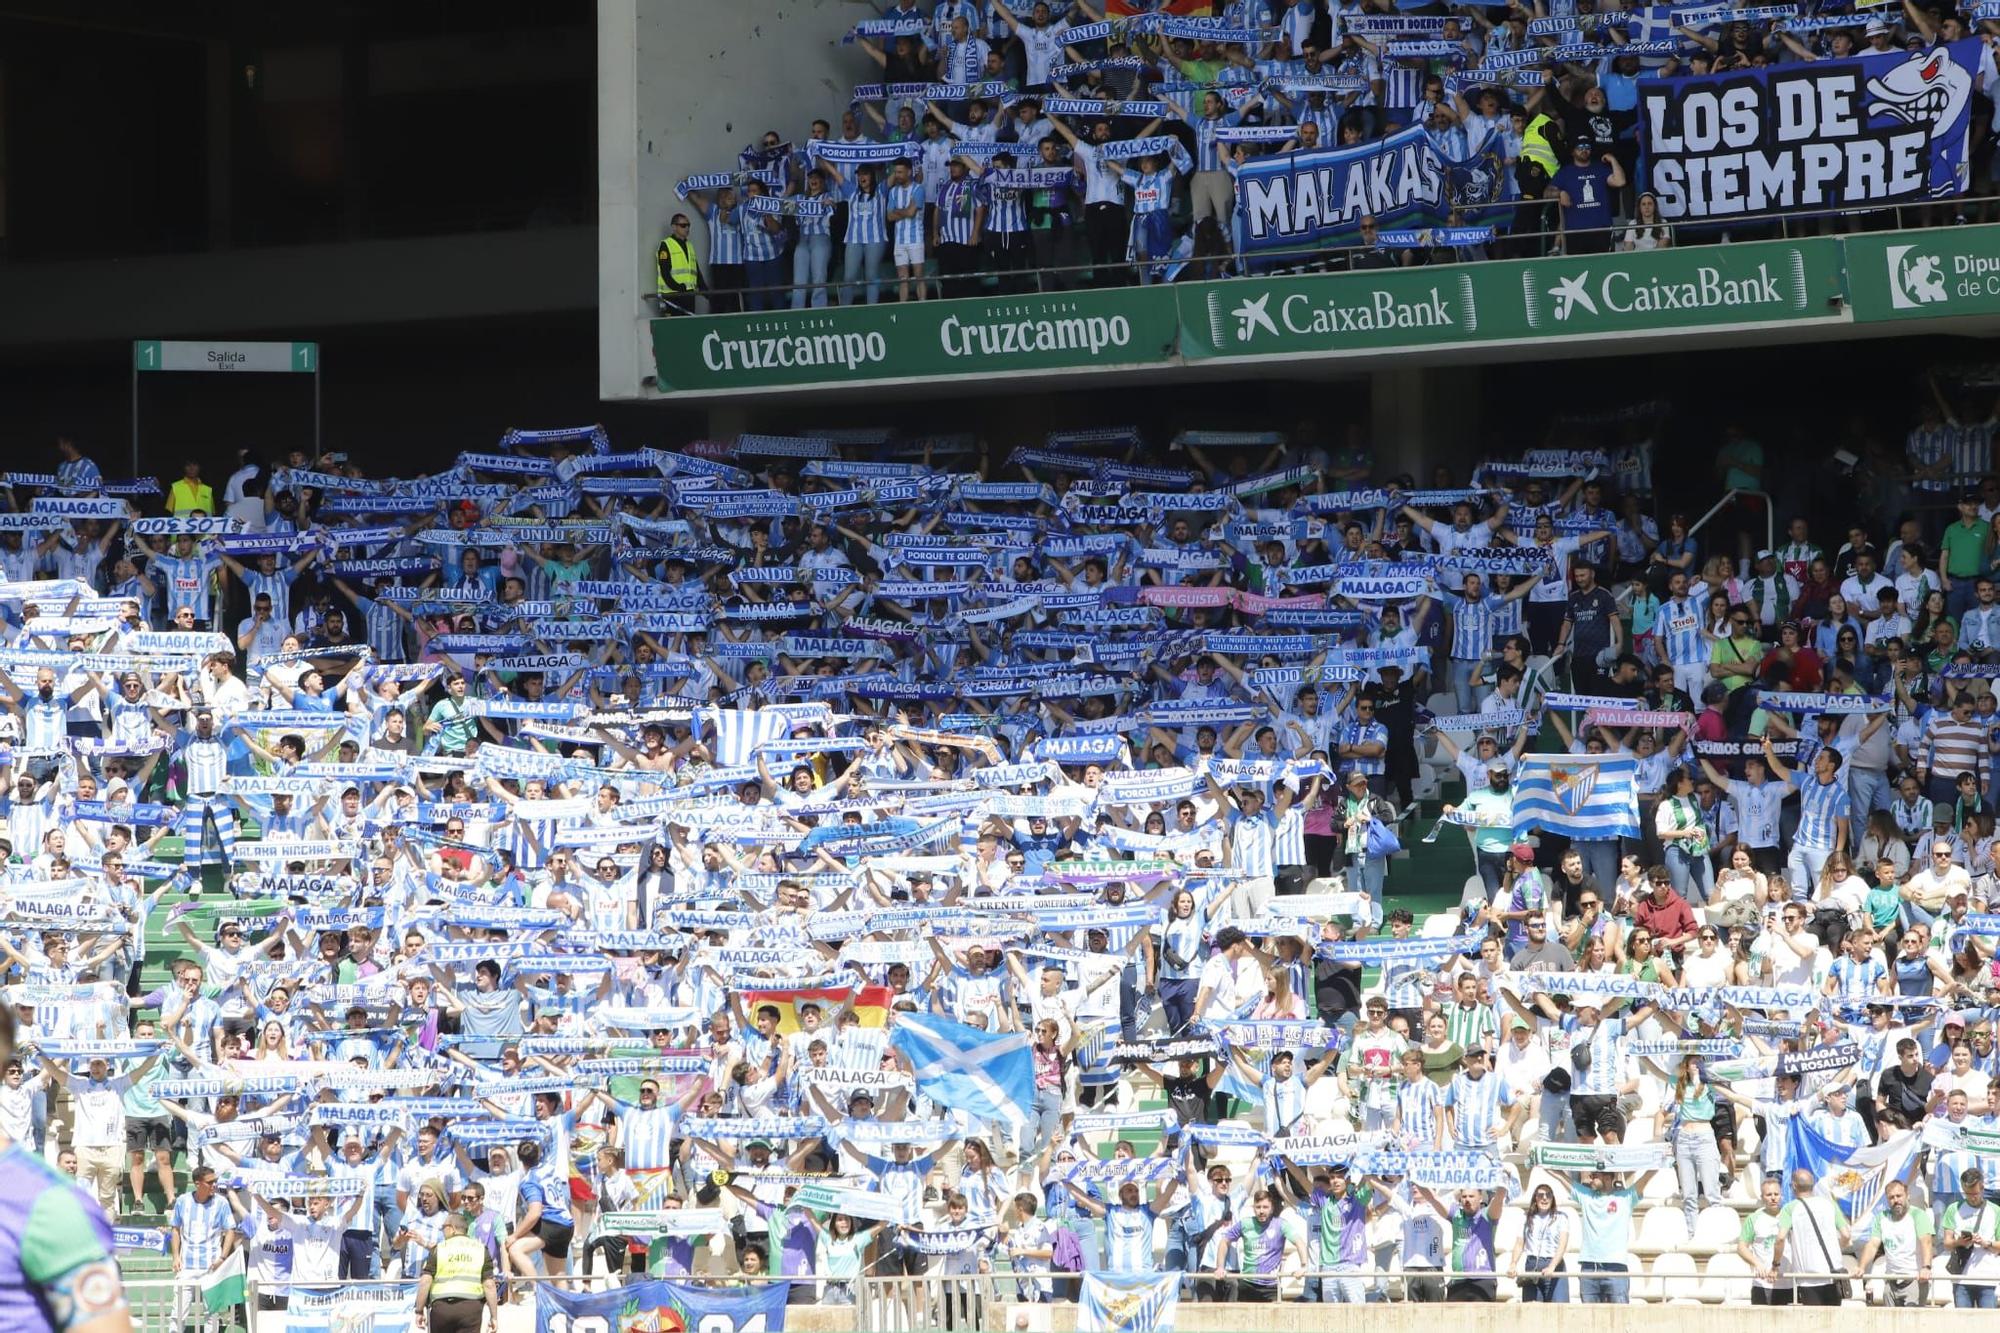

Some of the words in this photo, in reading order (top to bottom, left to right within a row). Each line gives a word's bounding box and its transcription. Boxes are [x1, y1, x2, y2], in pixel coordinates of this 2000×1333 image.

[864, 18, 924, 34] MALAGA
[1533, 18, 1576, 32] ONDO
[1791, 13, 1880, 29] MALAGA
[1388, 42, 1449, 54] MALAGA
[926, 86, 966, 98] ONDO
[1049, 101, 1102, 113] FONDO
[1124, 103, 1158, 114] SUR
[1647, 86, 1759, 152] LOS
[1776, 75, 1859, 141] DE
[1229, 128, 1285, 138] MALAGA
[821, 147, 855, 158] PORQUE
[858, 148, 869, 157] TE
[871, 147, 901, 157] QUIERO
[1105, 138, 1171, 157] MALAGA
[996, 168, 1066, 184] Malaga
[1652, 131, 1926, 217] SIEMPRE
[1245, 143, 1442, 240] MALAKAS
[1601, 263, 1783, 312] CaixaBank
[1957, 278, 1981, 297] de
[1282, 288, 1454, 334] CaixaBank
[941, 313, 1131, 357] Cruzcampo
[144, 346, 154, 366] 1
[702, 329, 886, 371] Cruzcampo
[207, 351, 246, 363] Salida
[300, 347, 308, 368] 1
[218, 362, 235, 370] Exit
[466, 455, 528, 470] MALAGA
[295, 472, 374, 489] MALAGA
[416, 485, 498, 498] MALAGA
[805, 491, 856, 506] FONDO
[880, 487, 913, 498] SUR
[1317, 489, 1384, 507] MALAGA
[342, 498, 426, 511] MALAGA
[1152, 495, 1226, 508] MALAGA
[1083, 507, 1148, 520] MALAGA
[137, 519, 181, 533] 300
[187, 518, 228, 533] LOS
[948, 514, 1030, 527] MALAGA
[1051, 536, 1116, 551] MALAGA
[908, 551, 943, 560] PORQUE
[946, 552, 955, 560] TE
[958, 552, 988, 561] QUIERO
[1143, 551, 1213, 564] MALAGA
[343, 559, 395, 572] MALAGA
[1429, 557, 1515, 571] MALAGA
[739, 569, 792, 580] FONDO
[817, 569, 851, 581] SUR
[577, 584, 628, 595] MALAGA
[886, 585, 945, 594] MALAGA
[625, 597, 707, 609] MALAGA
[740, 604, 795, 614] MALAGA
[1069, 610, 1142, 621] MALAGA
[1273, 613, 1351, 625] MALAGA
[538, 623, 612, 636] MALAGA
[138, 633, 190, 648] MALAGA
[449, 636, 508, 647] MALAGA
[794, 638, 866, 652] MALAGA
[1018, 634, 1098, 645] MALAGA
[1346, 651, 1380, 661] SIEMPRE
[1383, 648, 1416, 659] MALAGA
[984, 666, 1068, 678] MALAGA
[1254, 668, 1300, 682] ONDO
[1324, 666, 1358, 681] SUR
[867, 682, 920, 693] MALAGA
[1044, 678, 1116, 697] MALAGA
[1557, 698, 1623, 707] MALAGA
[1787, 694, 1864, 709] MALAGA
[491, 704, 540, 714] MALAGA
[543, 704, 569, 714] C.F.
[1169, 711, 1235, 720] MALAGA
[248, 714, 335, 727] MALAGA
[1597, 713, 1680, 724] MALAGUISTA
[772, 739, 858, 749] MALAGA
[1046, 738, 1115, 754] MALAGA
[1697, 742, 1739, 754] SOMOS
[978, 766, 1048, 784] MALAGA
[234, 780, 313, 792] MALAGA
[1119, 787, 1155, 797] PORQUE
[668, 813, 753, 826] MALAGA
[261, 878, 334, 892] MALAGA
[16, 901, 72, 916] MALAGA
[76, 904, 98, 917] C.F.
[980, 901, 1023, 909] FRENTE
[672, 913, 750, 926] MALAGA
[1059, 912, 1127, 923] MALAGA
[600, 934, 684, 947] MALAGA
[441, 942, 526, 959] MALAGA
[1345, 943, 1435, 956] MALAGA
[521, 959, 611, 970] MALAGA
[1551, 977, 1639, 994] MALAGA
[1723, 988, 1813, 1007] MALAGA
[1702, 1041, 1731, 1053] SUR
[1784, 1049, 1839, 1064] MALAGA
[666, 1058, 701, 1072] SUR
[1785, 1063, 1798, 1073] LA
[1801, 1055, 1856, 1072] ROSALEDA
[161, 1082, 221, 1096] FONDO
[247, 1078, 286, 1092] SUR
[319, 1103, 375, 1120] MALAGA
[1416, 1170, 1472, 1184] MALAGA
[919, 1232, 975, 1244] MALAGA
[263, 1244, 288, 1254] MALAGA
[335, 1289, 404, 1304] MALAGUISTA
